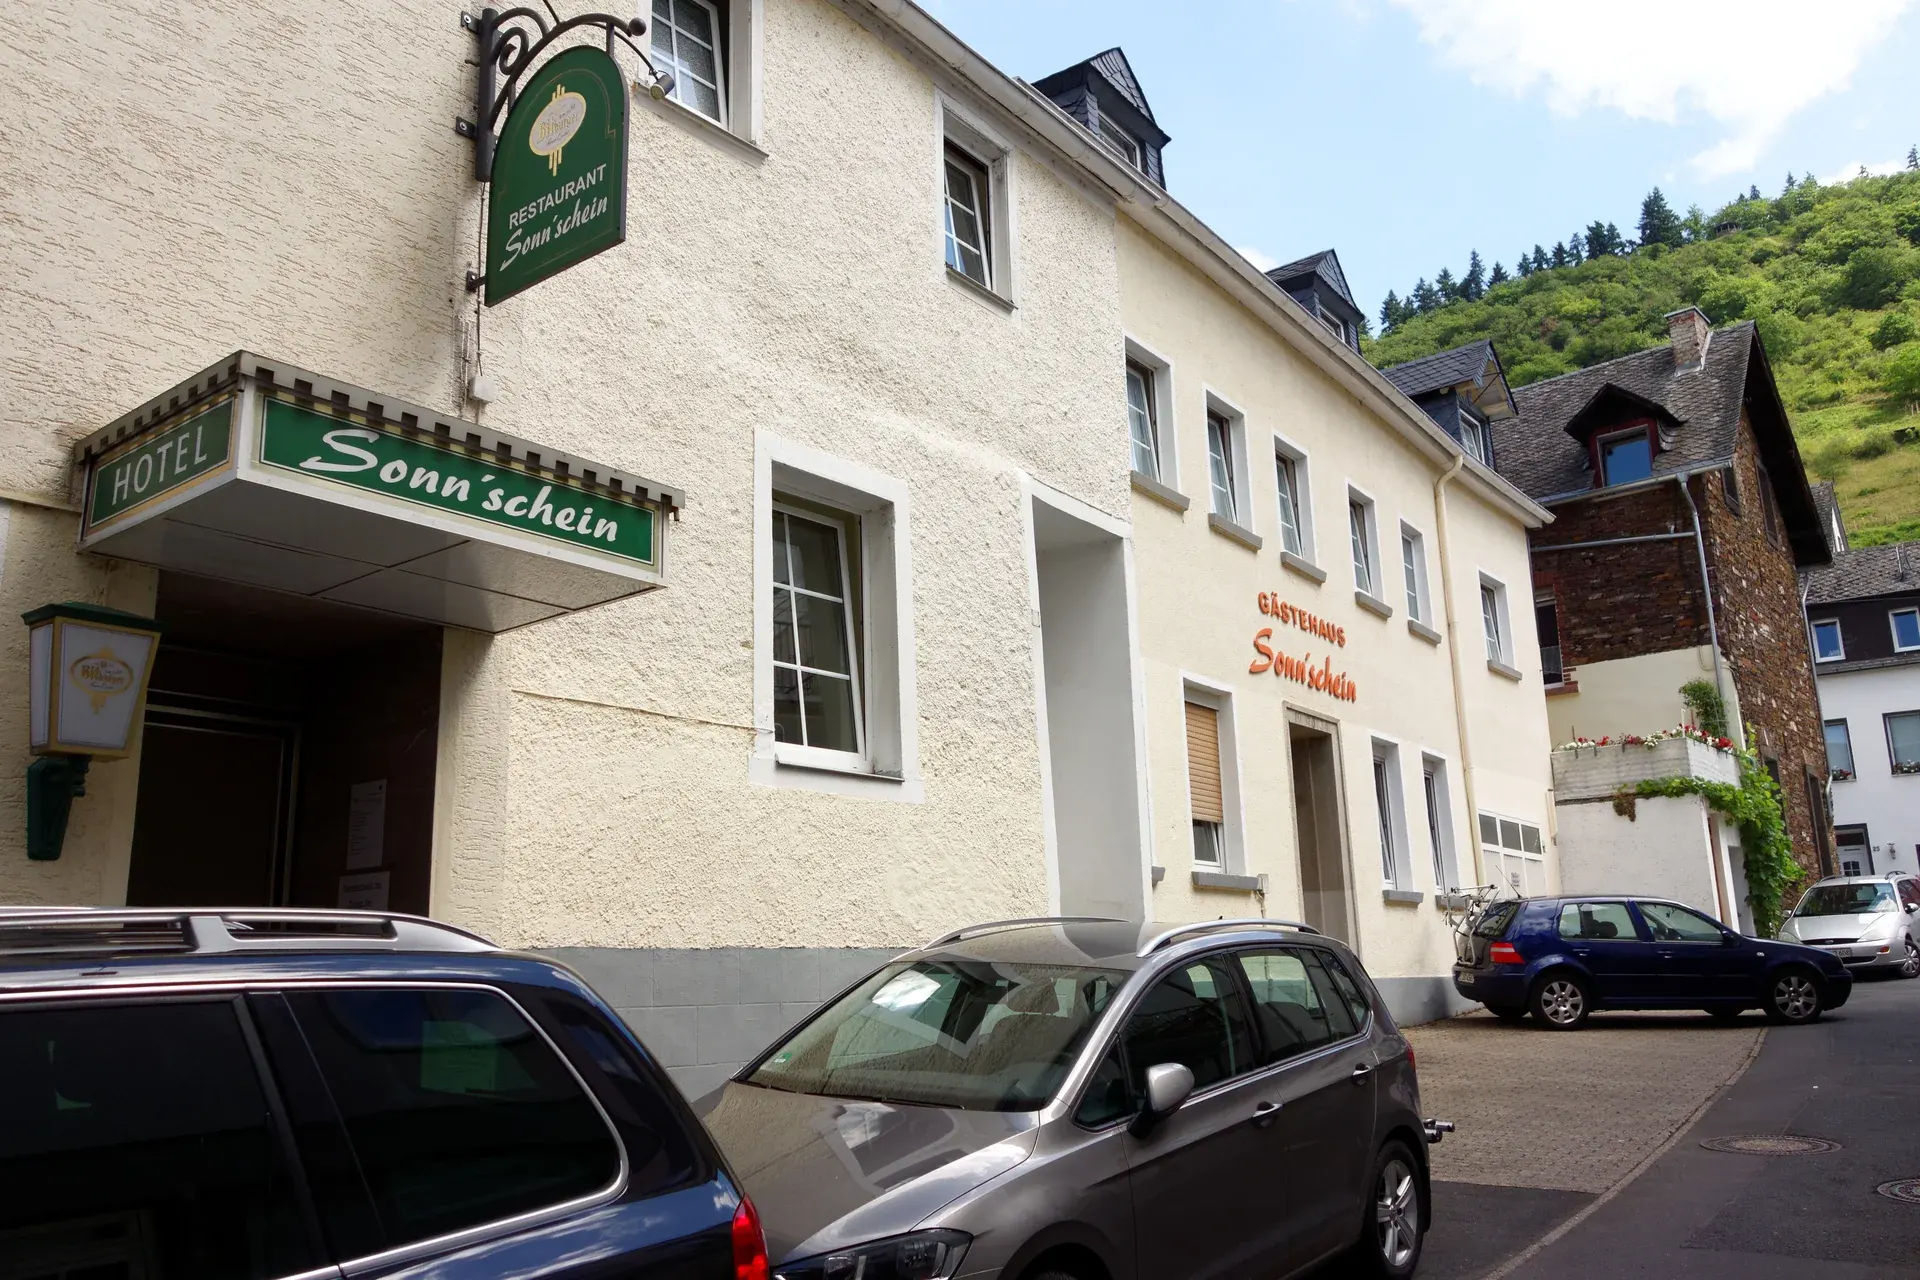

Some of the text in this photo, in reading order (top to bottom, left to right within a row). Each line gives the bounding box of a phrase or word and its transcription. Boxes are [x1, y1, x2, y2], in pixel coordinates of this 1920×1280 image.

[509, 163, 607, 229] RESTAURANT
[111, 424, 208, 507] HOTEL
[1258, 591, 1346, 648] GÄSTEHAUS
